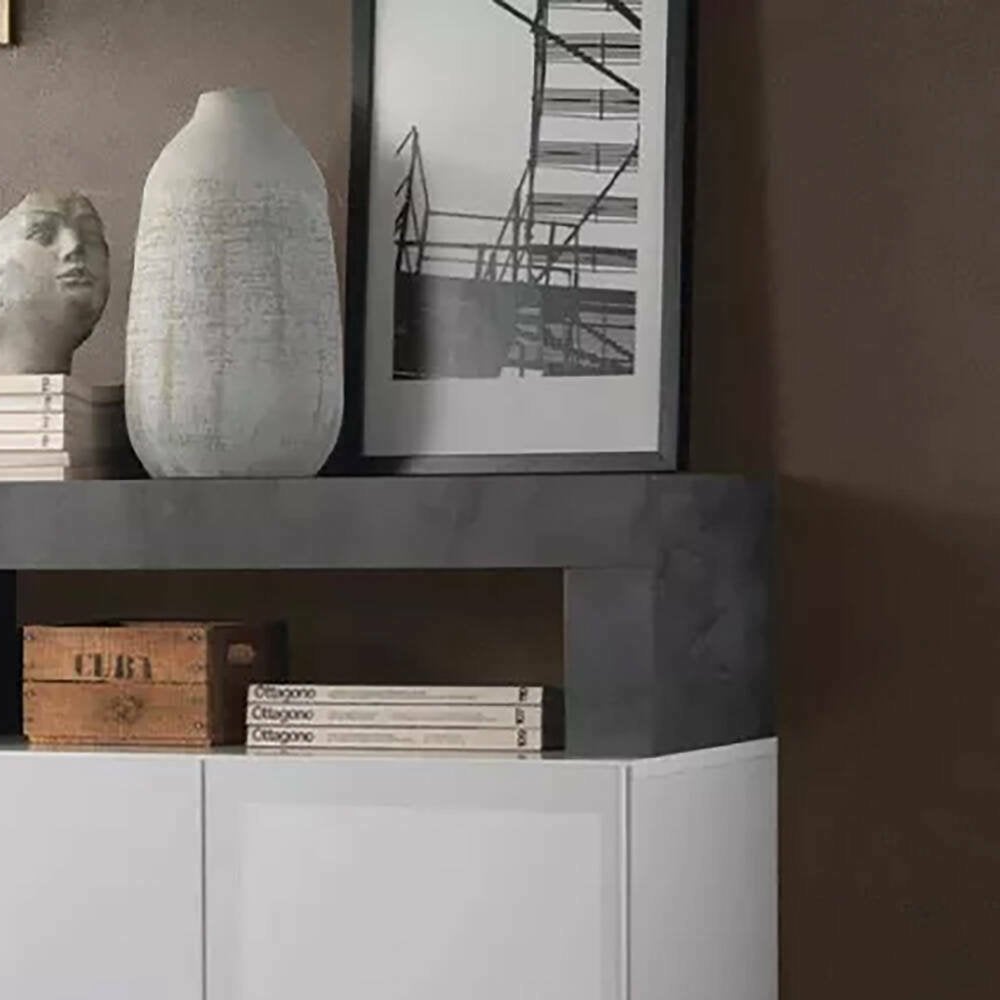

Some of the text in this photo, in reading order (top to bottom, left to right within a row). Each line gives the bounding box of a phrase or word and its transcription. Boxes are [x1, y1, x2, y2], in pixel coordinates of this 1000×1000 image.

[74, 653, 152, 678] CUBA
[254, 685, 316, 702] Ottagono
[252, 705, 314, 723] Ottagono
[252, 727, 315, 745] Ottagono
